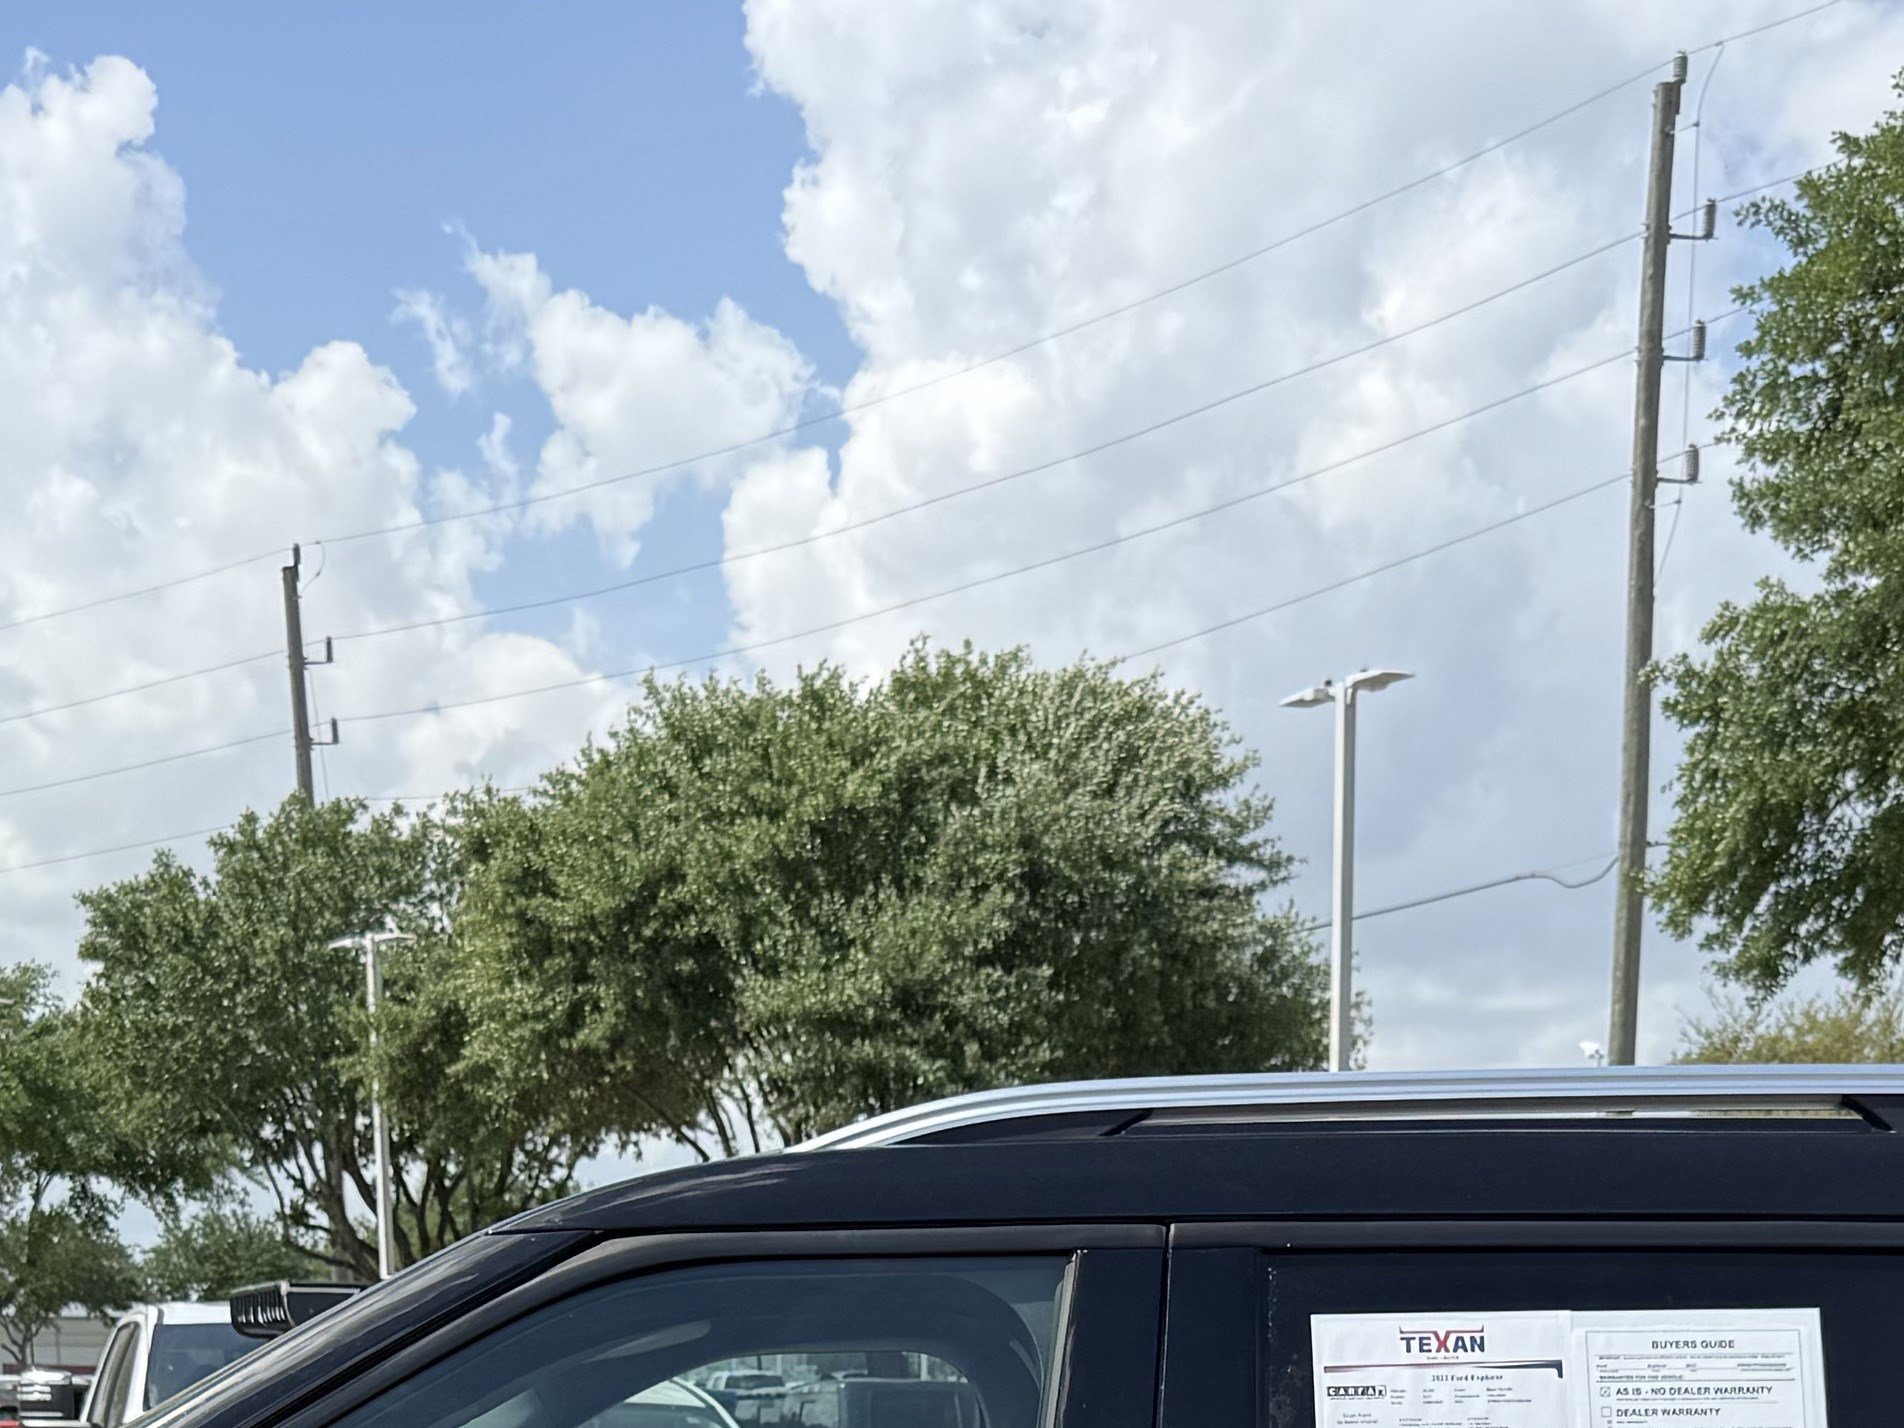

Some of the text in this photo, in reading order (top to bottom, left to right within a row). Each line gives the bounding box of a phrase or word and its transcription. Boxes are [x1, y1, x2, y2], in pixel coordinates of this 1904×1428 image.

[1399, 1332, 1485, 1353] TEXAN
[1652, 1340, 1735, 1349] BUYERS GUIDE
[1616, 1387, 1629, 1396] AS
[1651, 1387, 1666, 1395] NO
[1669, 1387, 1711, 1396] DEALER
[1714, 1386, 1773, 1395] WARRANTY
[1617, 1408, 1721, 1417] DEALER WARRANTY
